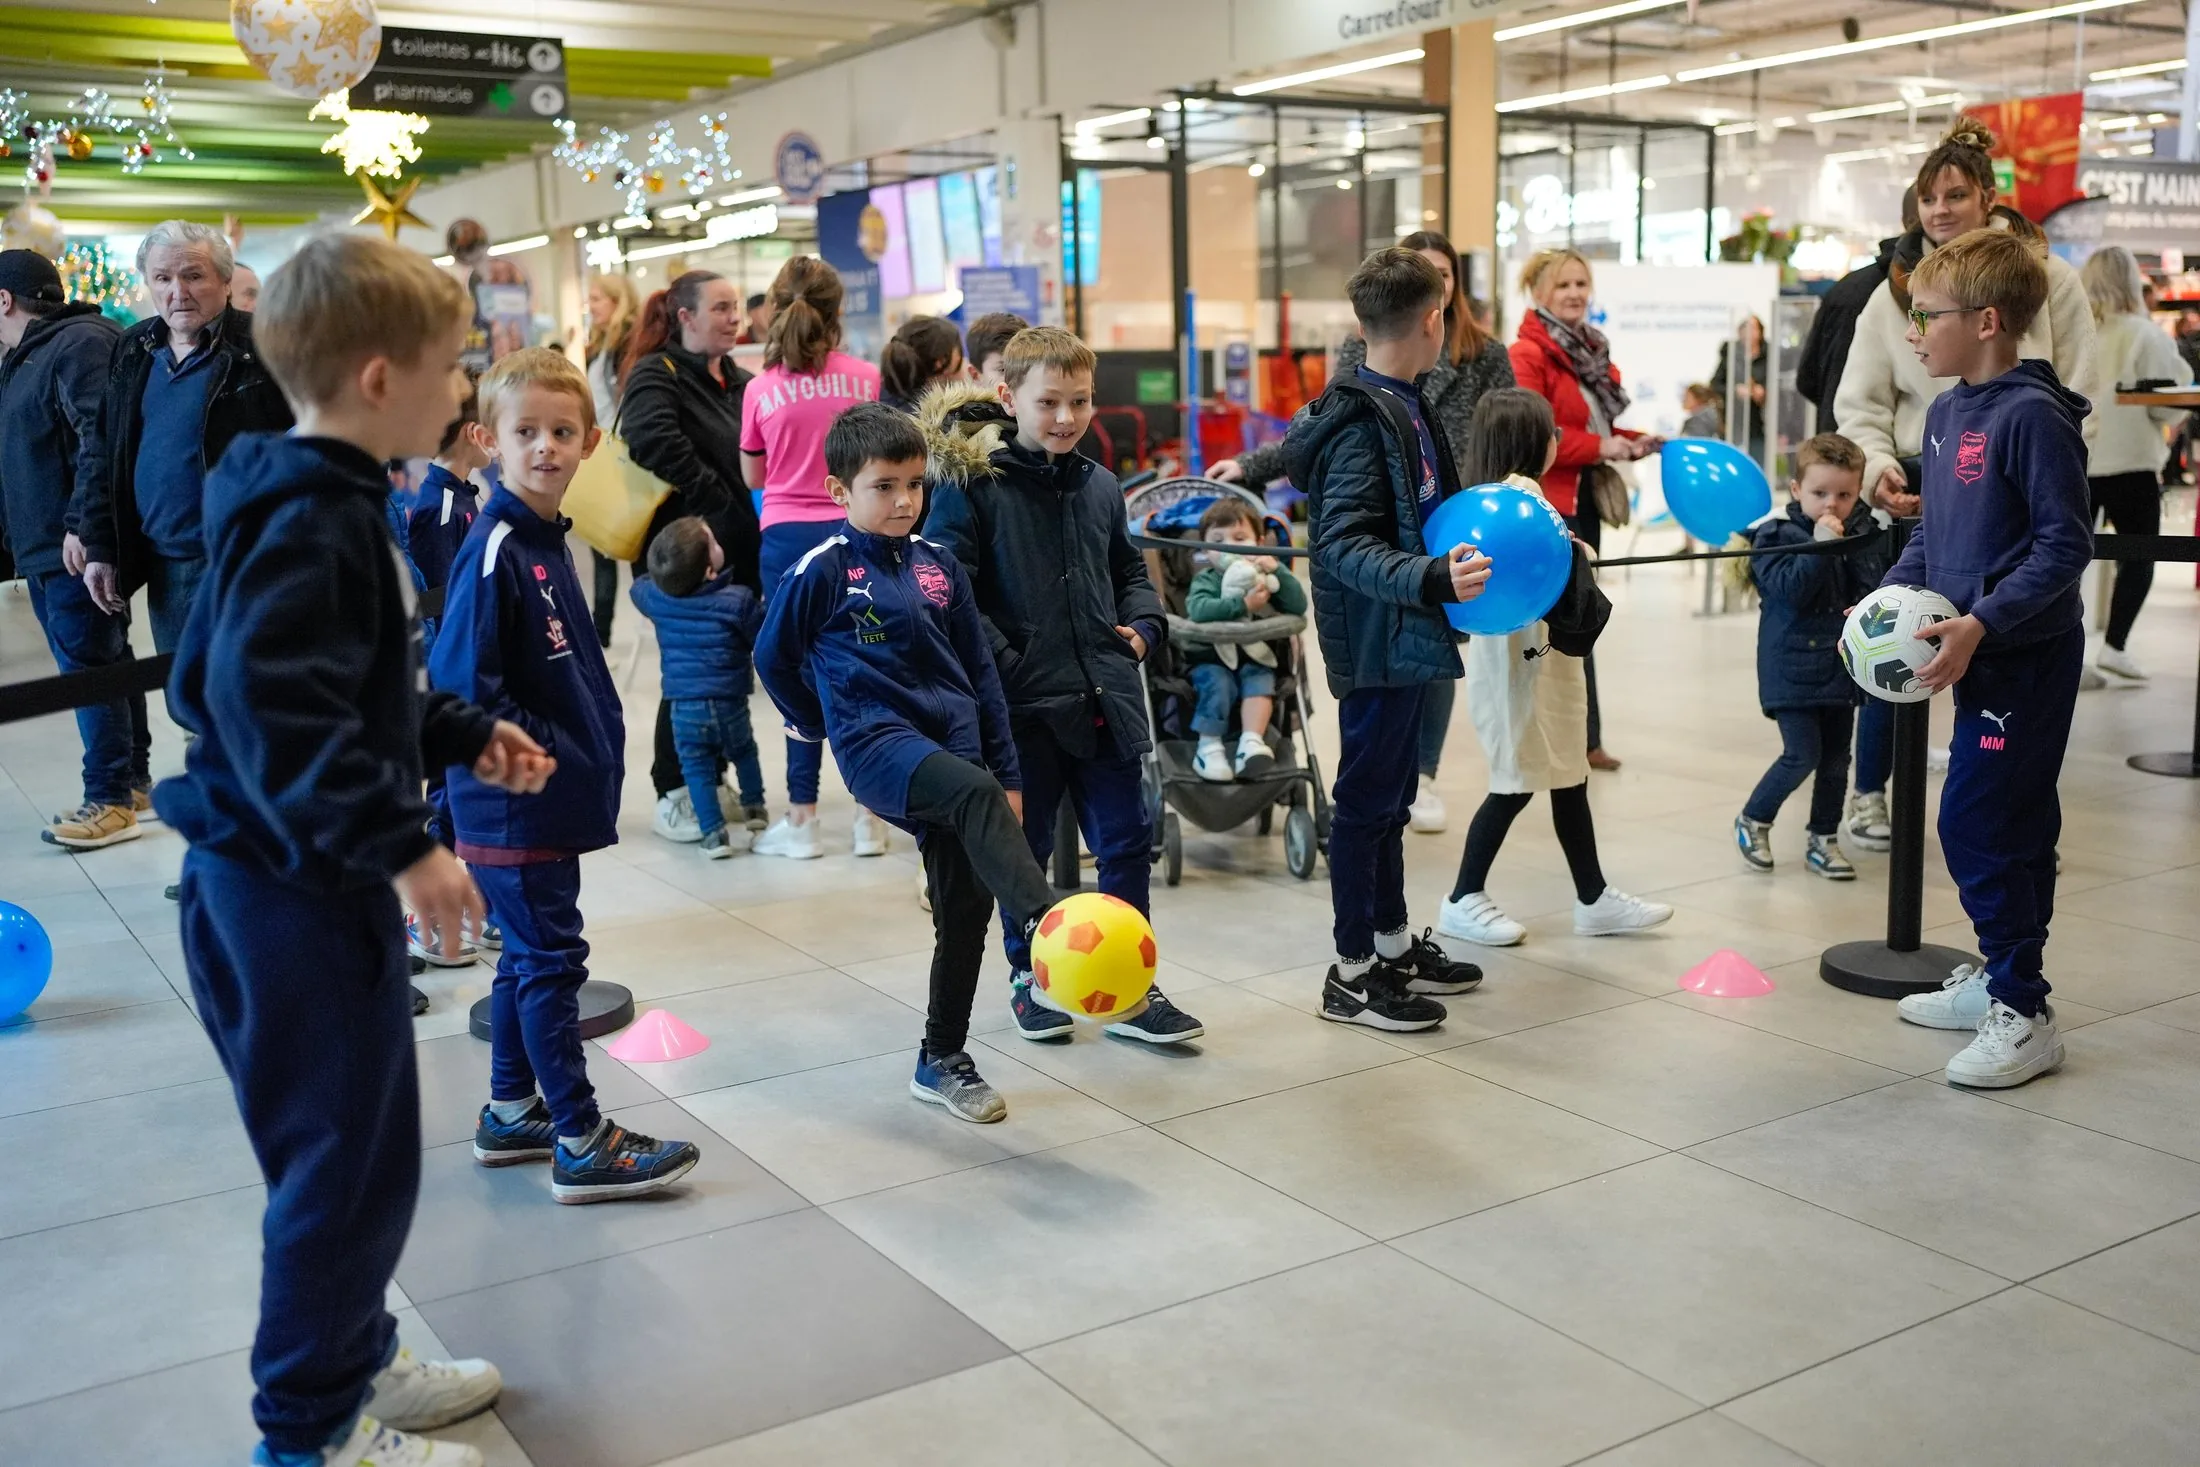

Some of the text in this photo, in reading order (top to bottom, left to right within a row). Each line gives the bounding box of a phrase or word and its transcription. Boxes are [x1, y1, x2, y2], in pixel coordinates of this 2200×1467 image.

[1338, 0, 1442, 39] Carrefour
[391, 37, 470, 60] toilettes
[374, 82, 473, 104] pharmacie
[2080, 169, 2144, 204] C'EST
[847, 567, 866, 581] NP
[862, 632, 887, 644] TETE
[1980, 735, 2005, 751] MM
